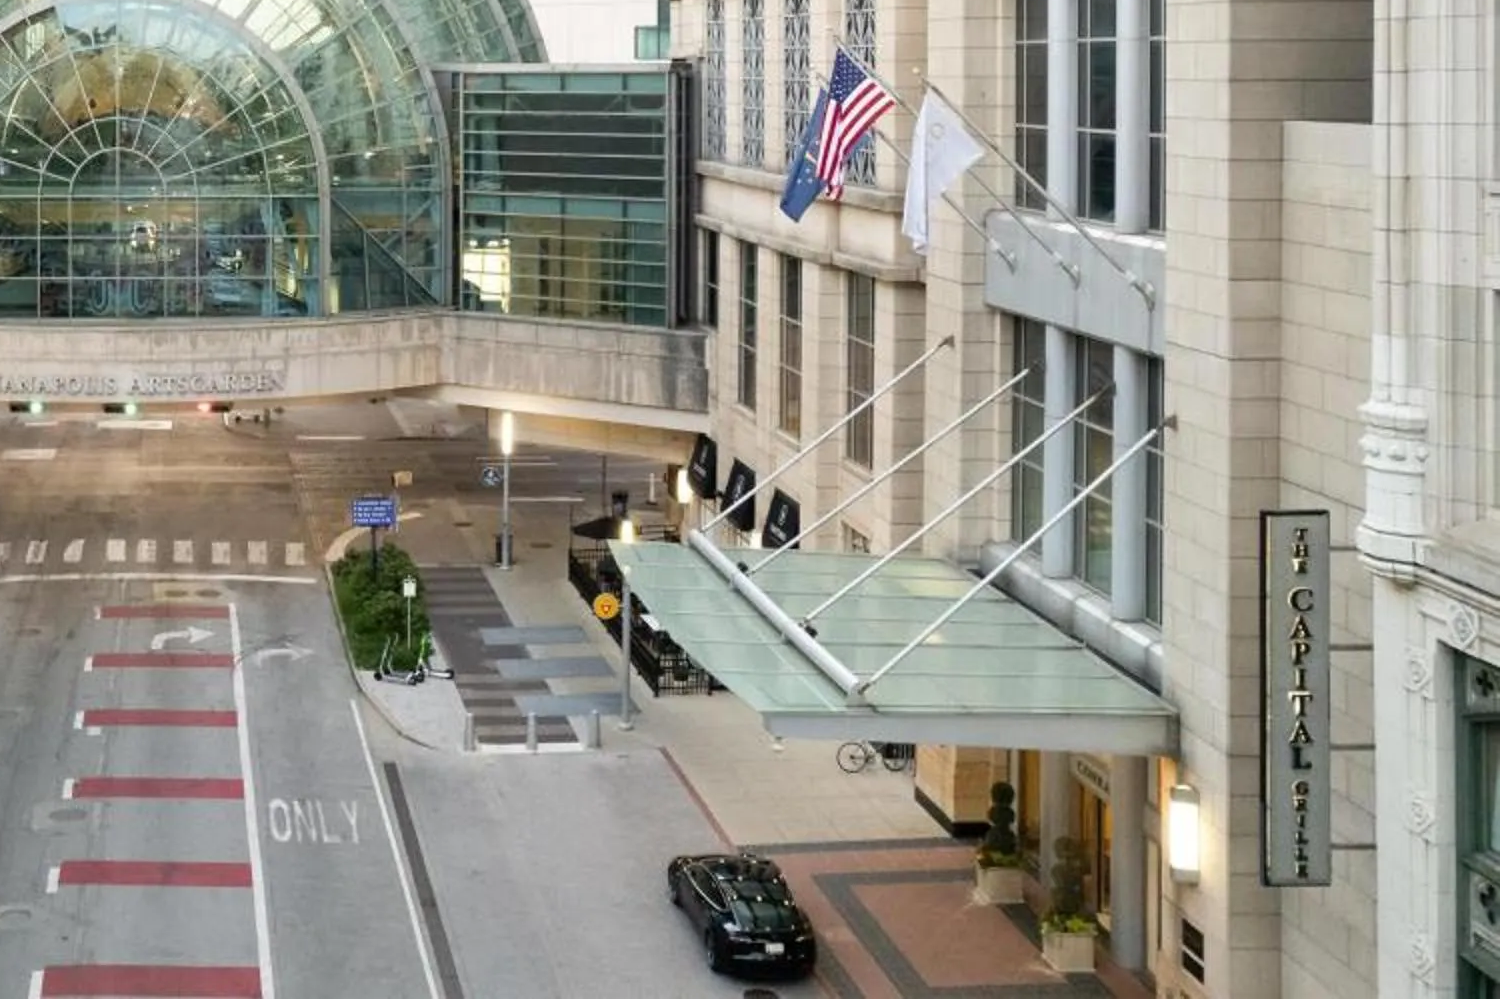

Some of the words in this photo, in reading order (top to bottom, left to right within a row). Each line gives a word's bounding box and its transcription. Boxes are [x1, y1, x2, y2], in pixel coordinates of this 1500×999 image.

[127, 371, 285, 396] ARTSGARDEN
[1292, 527, 1309, 574] THE
[1288, 586, 1314, 770] CAPITAL
[268, 798, 359, 843] ONLY
[1291, 780, 1309, 879] GRILLE
